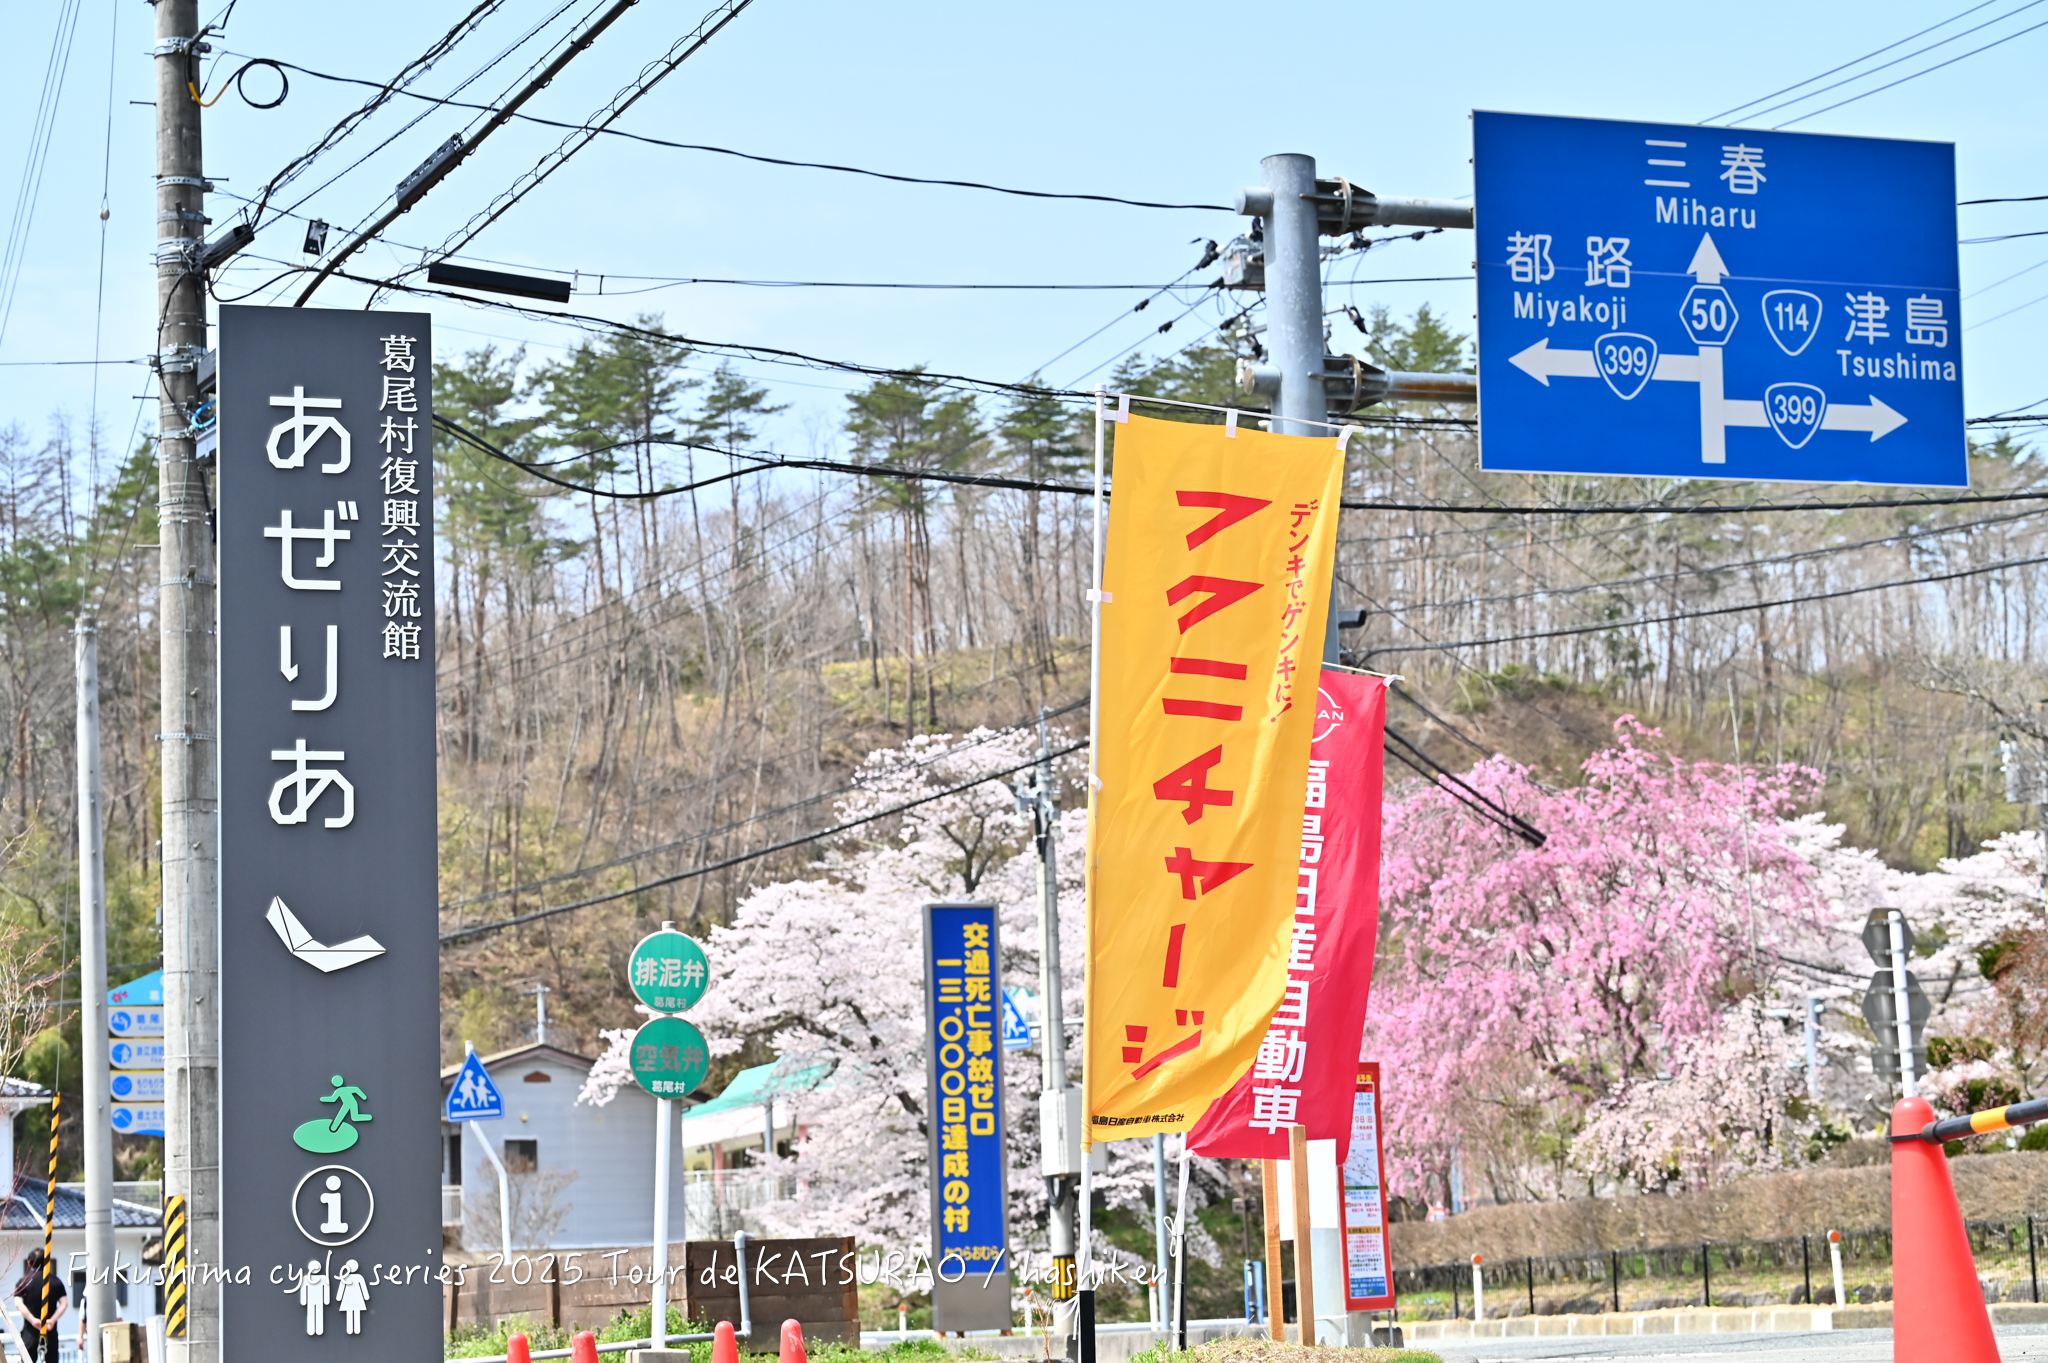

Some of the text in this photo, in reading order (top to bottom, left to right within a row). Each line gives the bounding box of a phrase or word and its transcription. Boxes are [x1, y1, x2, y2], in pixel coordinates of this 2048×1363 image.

[1644, 139, 1767, 195] 三春
[1656, 196, 1756, 229] Miharu
[1506, 231, 1632, 288] 都路
[1513, 291, 1627, 330] Miyakoji
[1691, 298, 1728, 332] 50
[1774, 302, 1809, 332] 114
[1844, 291, 1948, 348] 津島
[1604, 344, 1648, 376] 399
[1836, 349, 1957, 381] Tsushima
[1774, 394, 1816, 425] 399
[379, 334, 422, 661] 葛尾村復興交流館
[263, 386, 359, 829] あぜりあ
[635, 957, 705, 988] 排泥弁
[654, 997, 687, 1009] 葛尾村
[963, 922, 994, 1136] 交通死亡事故ゼロ
[635, 1044, 704, 1073] 空気弁
[652, 1080, 686, 1093] 葛尾村
